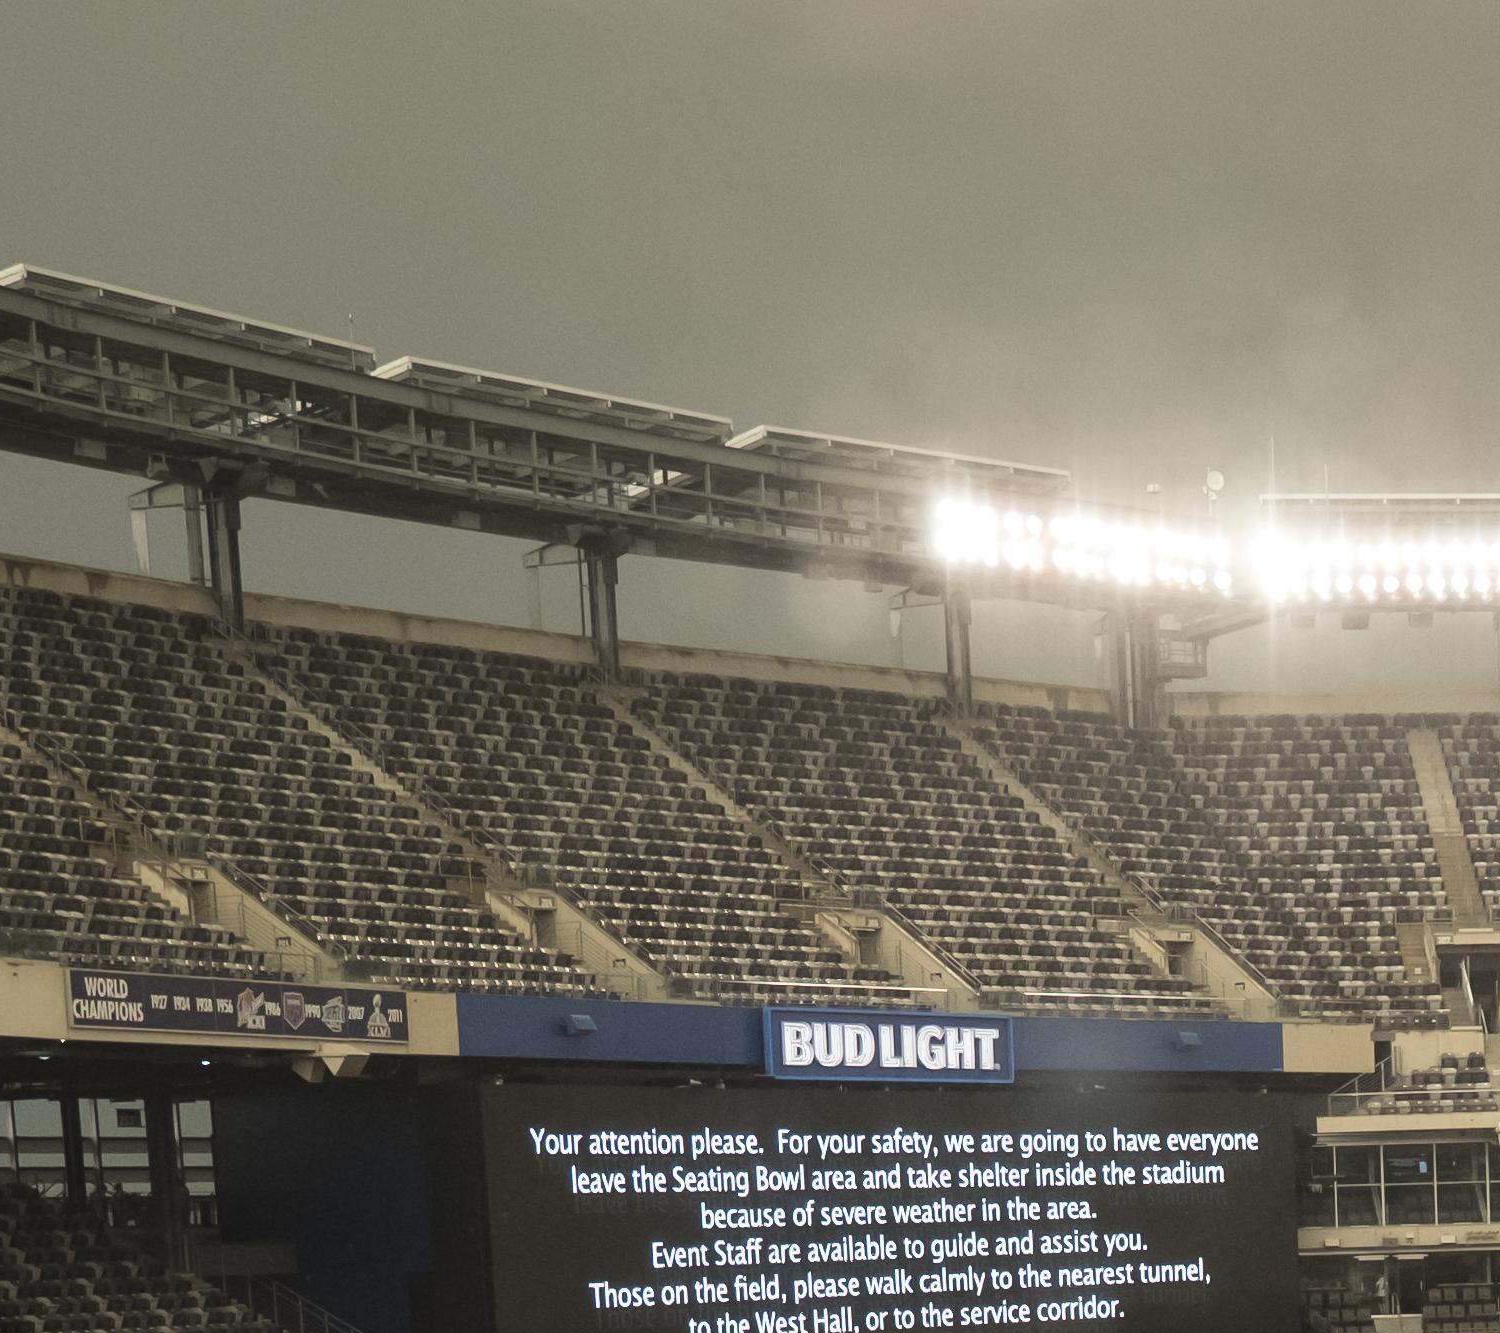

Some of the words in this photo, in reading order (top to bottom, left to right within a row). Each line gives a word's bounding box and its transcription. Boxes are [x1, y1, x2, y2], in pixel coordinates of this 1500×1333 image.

[84, 976, 128, 998] WORLD
[73, 1000, 144, 1022] CHAMPIONS
[216, 999, 233, 1013] 1956
[348, 1006, 364, 1020] 2007
[388, 1009, 403, 1023] 2011
[781, 1021, 875, 1067] BUD
[878, 1024, 999, 1070] LIGHT
[530, 1128, 582, 1154] Your
[590, 1128, 684, 1154] attention
[692, 1127, 763, 1160] please.
[778, 1129, 812, 1154] For
[817, 1134, 865, 1160] your
[872, 1127, 938, 1158] safety,
[944, 1135, 974, 1153] we
[981, 1134, 1013, 1152] are
[1020, 1129, 1078, 1158] going
[1085, 1132, 1106, 1151] to
[1113, 1127, 1161, 1151] have
[1167, 1133, 1258, 1155] everyone
[572, 1165, 626, 1193] leave
[632, 1165, 666, 1193] the
[672, 1166, 749, 1197] Seating
[756, 1164, 805, 1191] Bowl
[812, 1171, 857, 1191] area
[863, 1163, 900, 1189] and
[907, 1163, 951, 1188] take
[959, 1162, 1029, 1187] shelter
[1036, 1161, 1096, 1186] inside
[1102, 1160, 1135, 1185] the
[1143, 1160, 1225, 1184] stadium
[701, 1202, 786, 1229] because
[793, 1200, 814, 1226] of
[821, 1206, 887, 1225] severe
[893, 1198, 976, 1223] weather
[982, 1198, 1000, 1221] in
[1007, 1196, 1040, 1220] the
[1047, 1201, 1096, 1219] area.
[652, 1242, 709, 1268] Event
[714, 1238, 763, 1265] Staff
[769, 1244, 801, 1264] are
[808, 1234, 897, 1262] available
[904, 1238, 924, 1258] to
[930, 1232, 989, 1264] guide
[996, 1230, 1033, 1256] and
[1041, 1230, 1098, 1253] assist
[1104, 1234, 1147, 1256] you.
